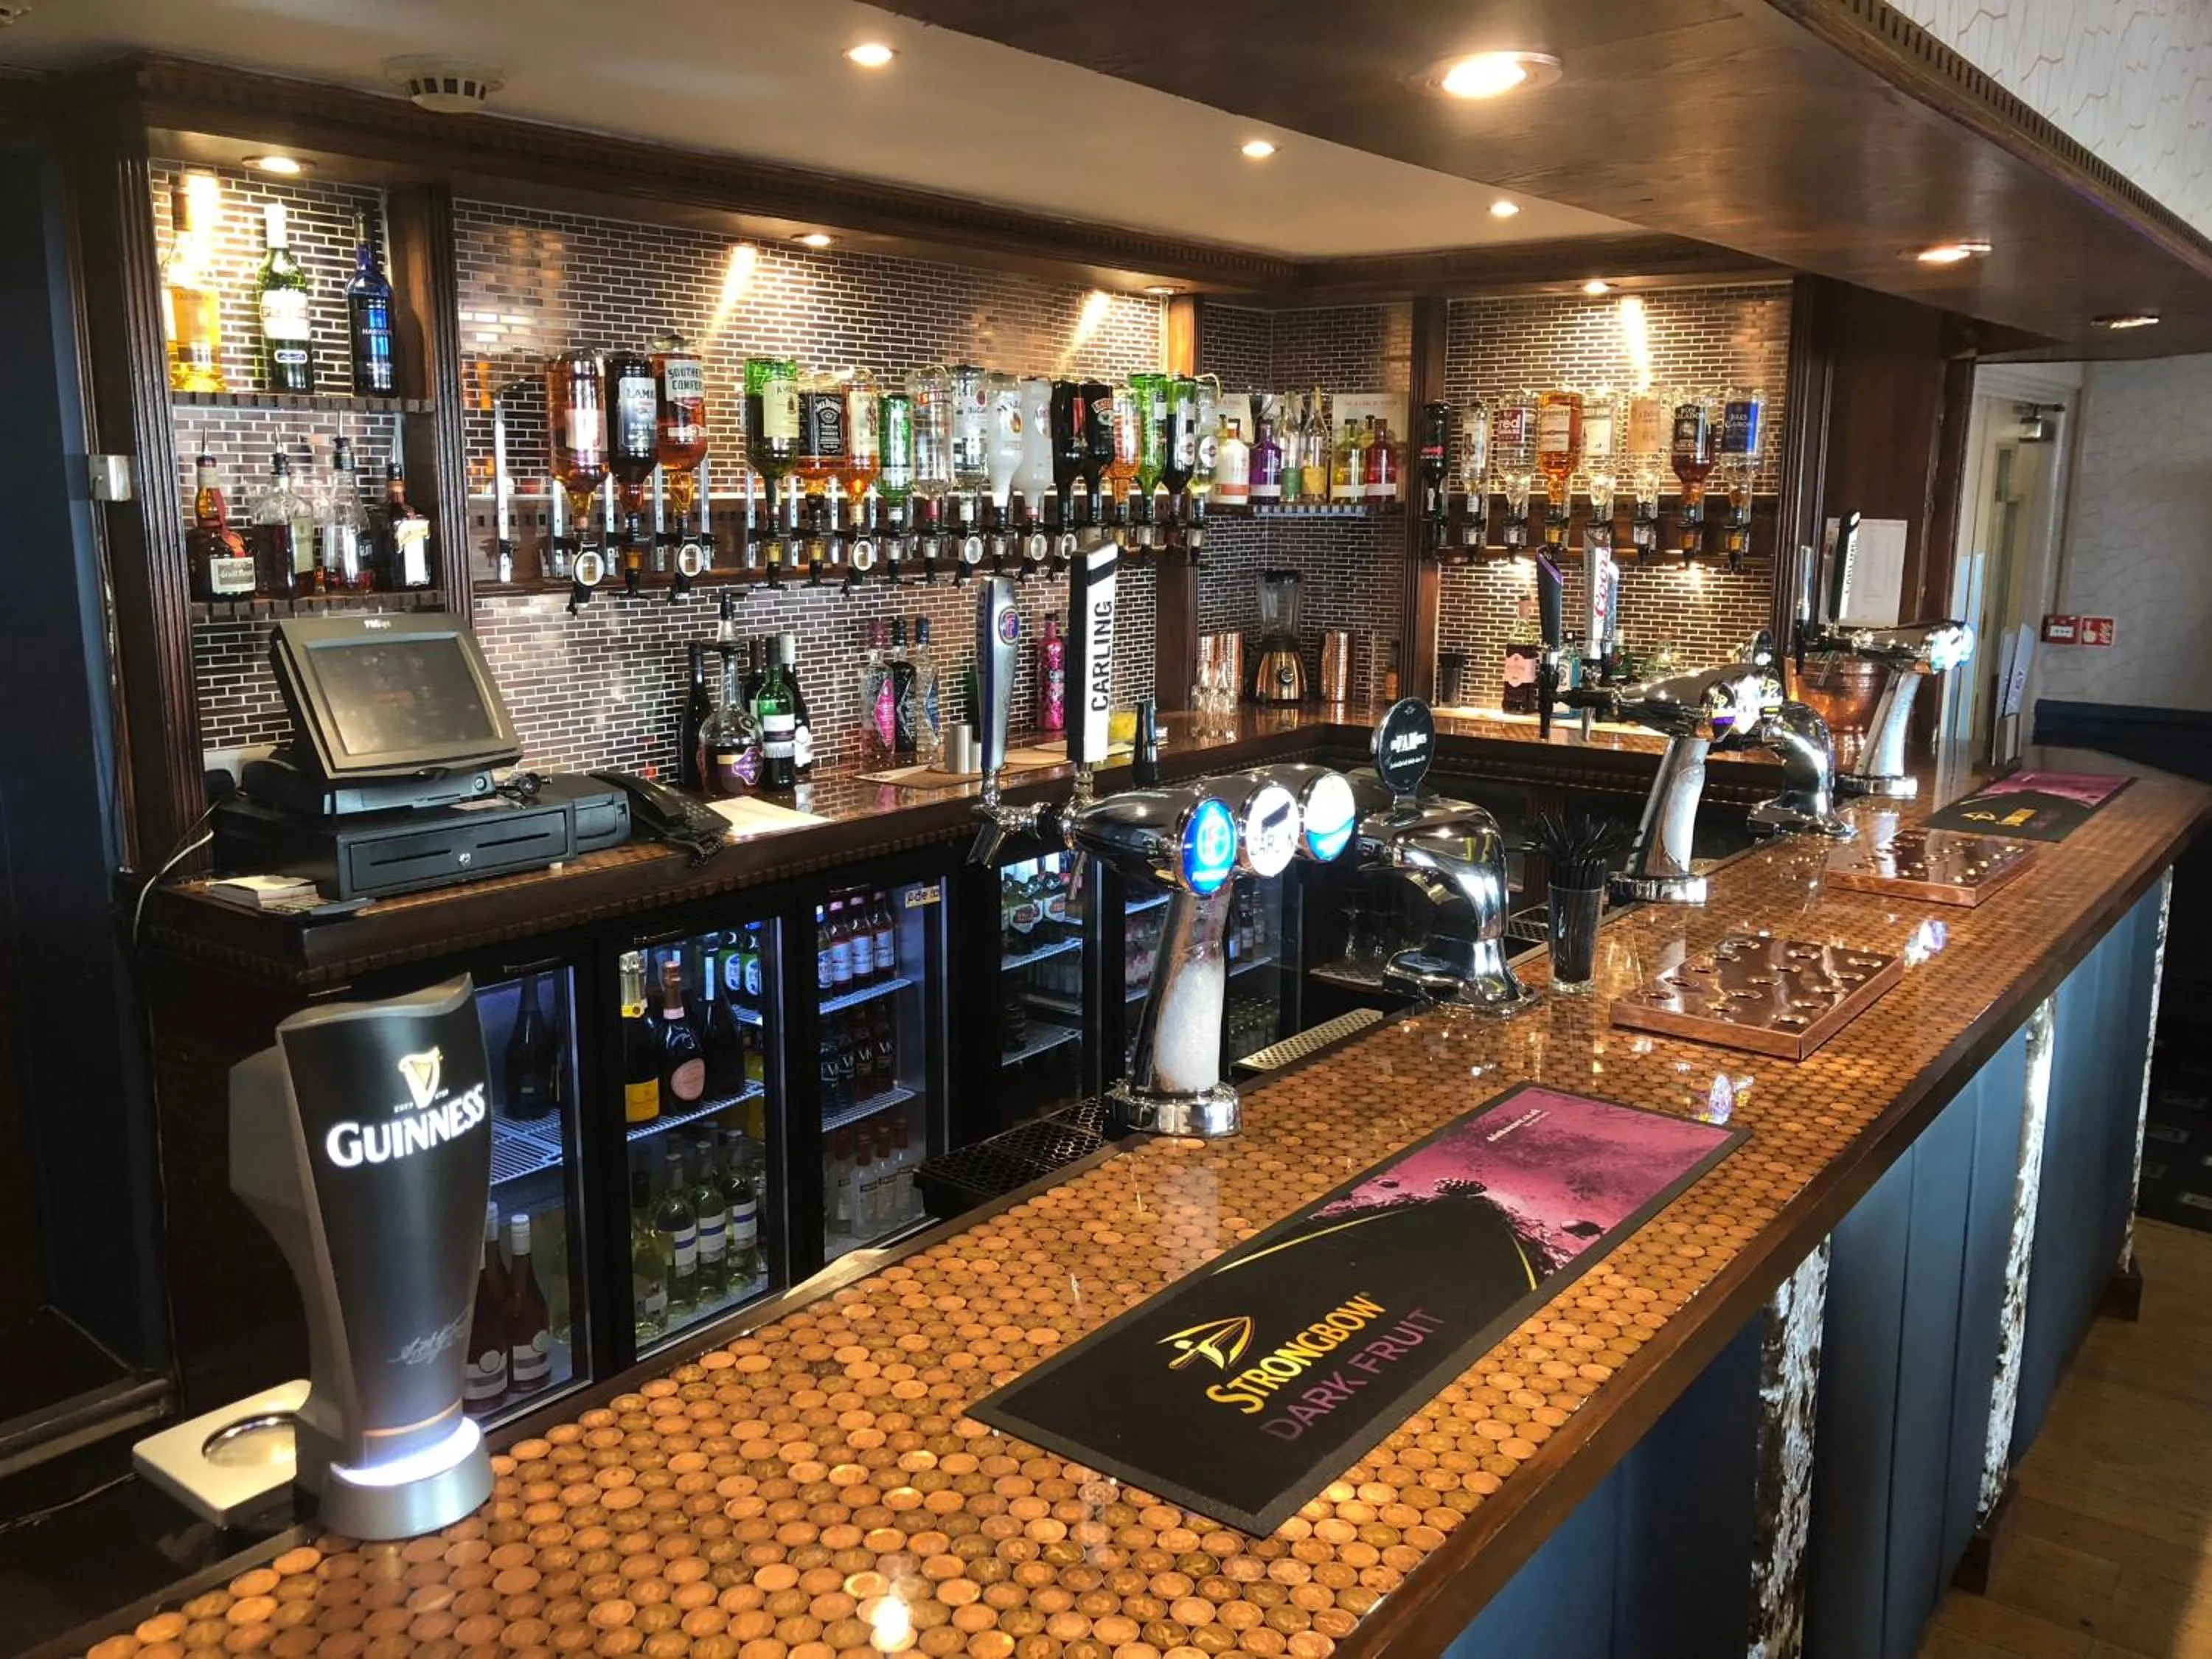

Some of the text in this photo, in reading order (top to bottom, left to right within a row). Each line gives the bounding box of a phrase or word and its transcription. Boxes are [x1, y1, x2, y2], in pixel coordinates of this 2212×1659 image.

[1091, 601, 1113, 711] CARLING
[327, 1082, 485, 1168] GUINNESS
[1205, 1295, 1386, 1414] STRONGBOW
[1259, 1308, 1445, 1441] DARK FRUIT
